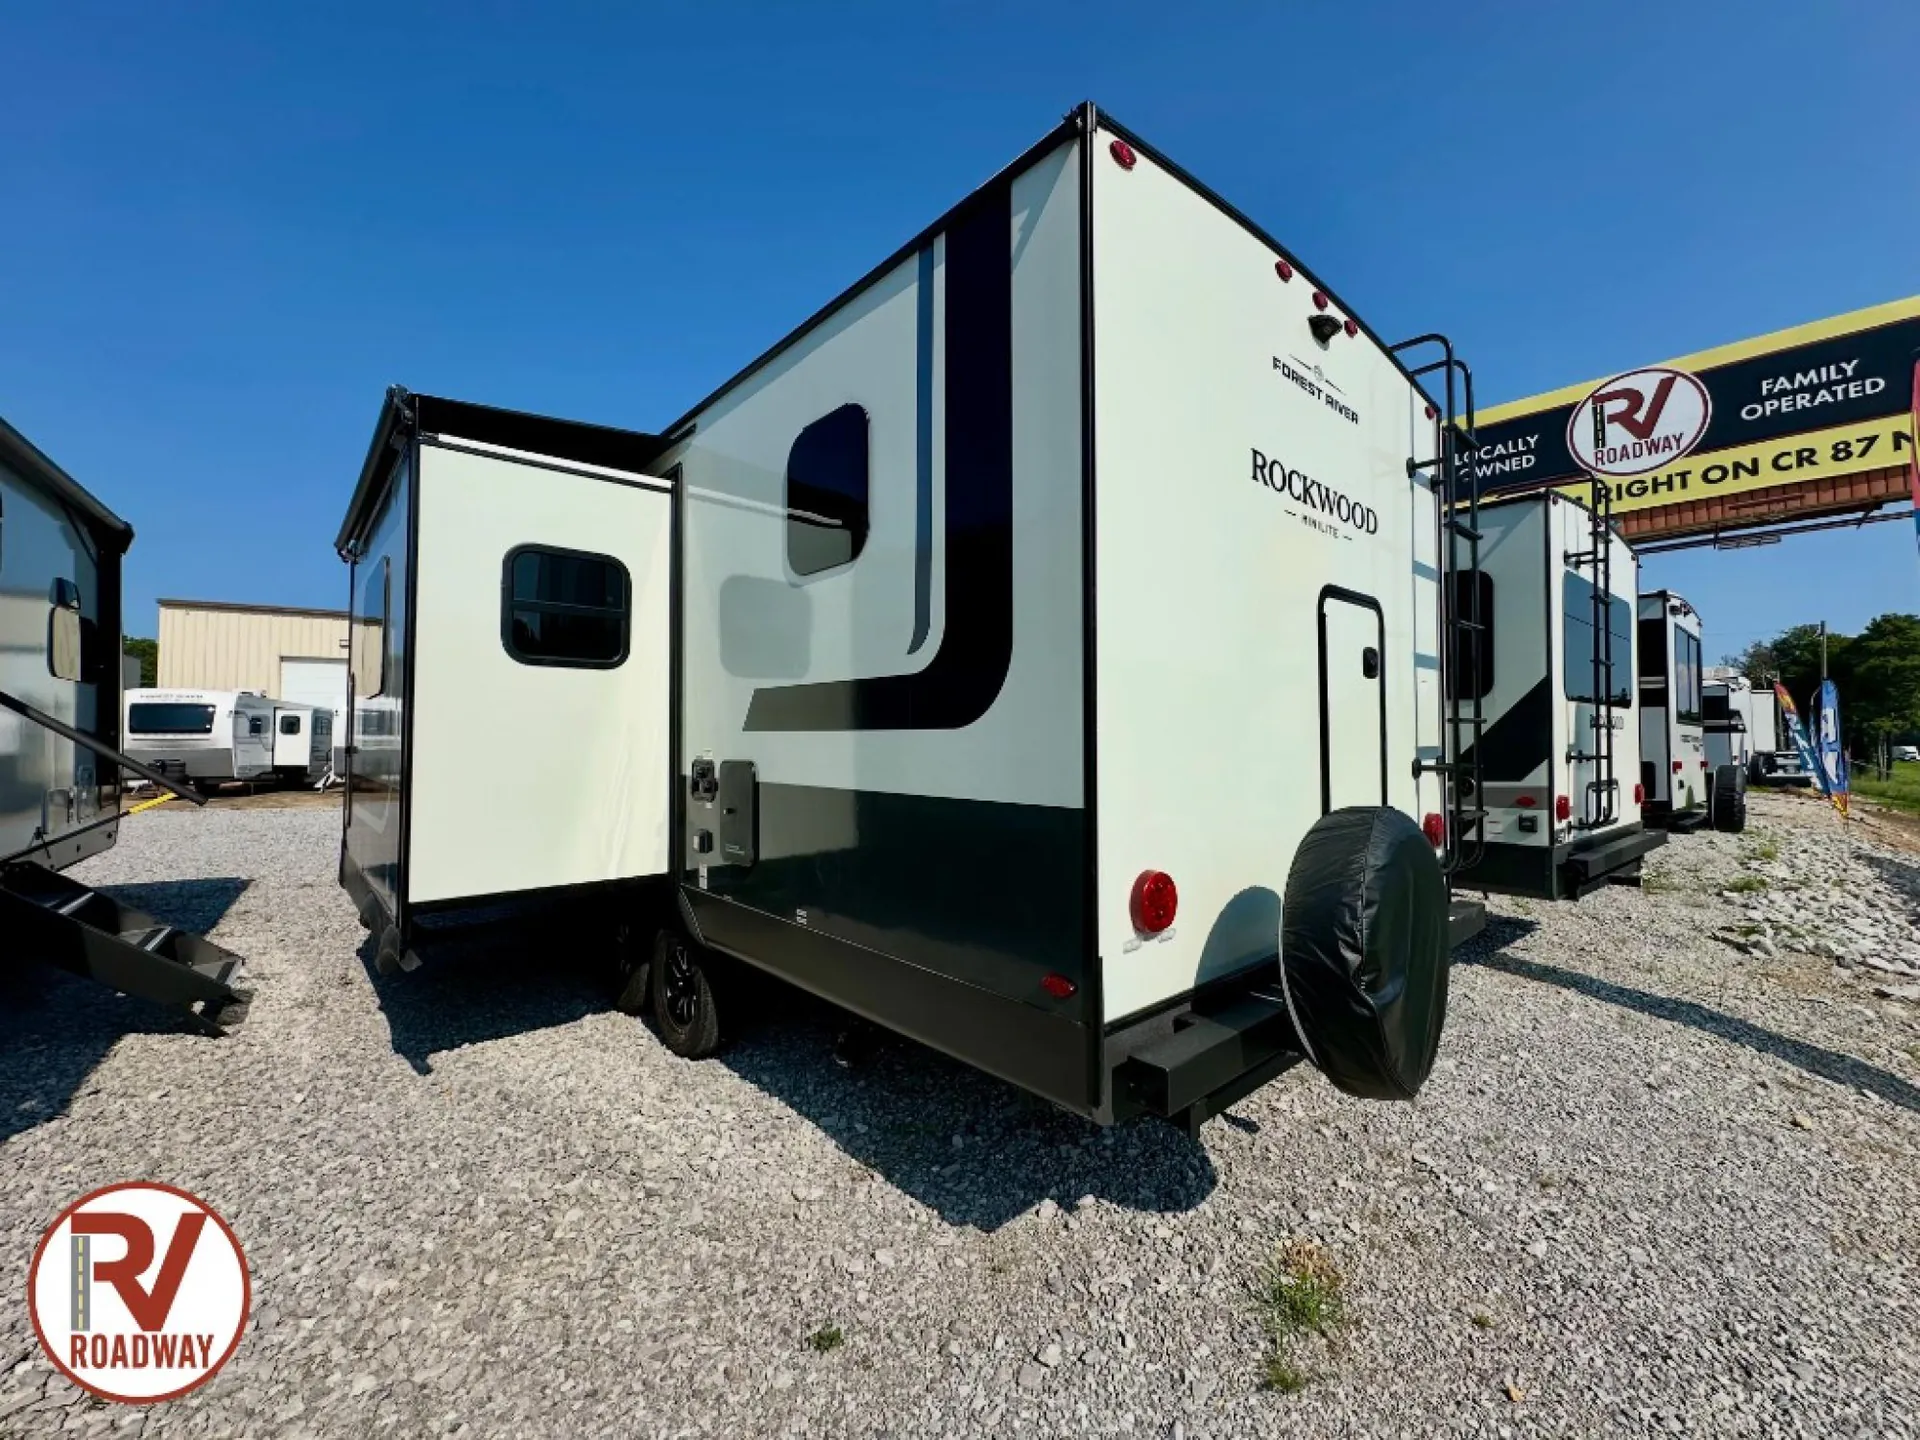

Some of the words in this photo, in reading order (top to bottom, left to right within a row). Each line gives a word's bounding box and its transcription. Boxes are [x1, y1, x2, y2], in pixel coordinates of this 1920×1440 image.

[1272, 355, 1323, 400] FOREST
[1325, 393, 1359, 424] RIVER
[1740, 378, 1885, 420] OPERATED
[1761, 358, 1859, 396] FAMILY
[1591, 375, 1677, 448] RV
[1594, 432, 1684, 466] ROADWAY
[1701, 457, 1760, 485] ON
[1771, 447, 1820, 472] CR
[1830, 434, 1880, 462] 87
[1250, 447, 1379, 535] ROCKWOOD
